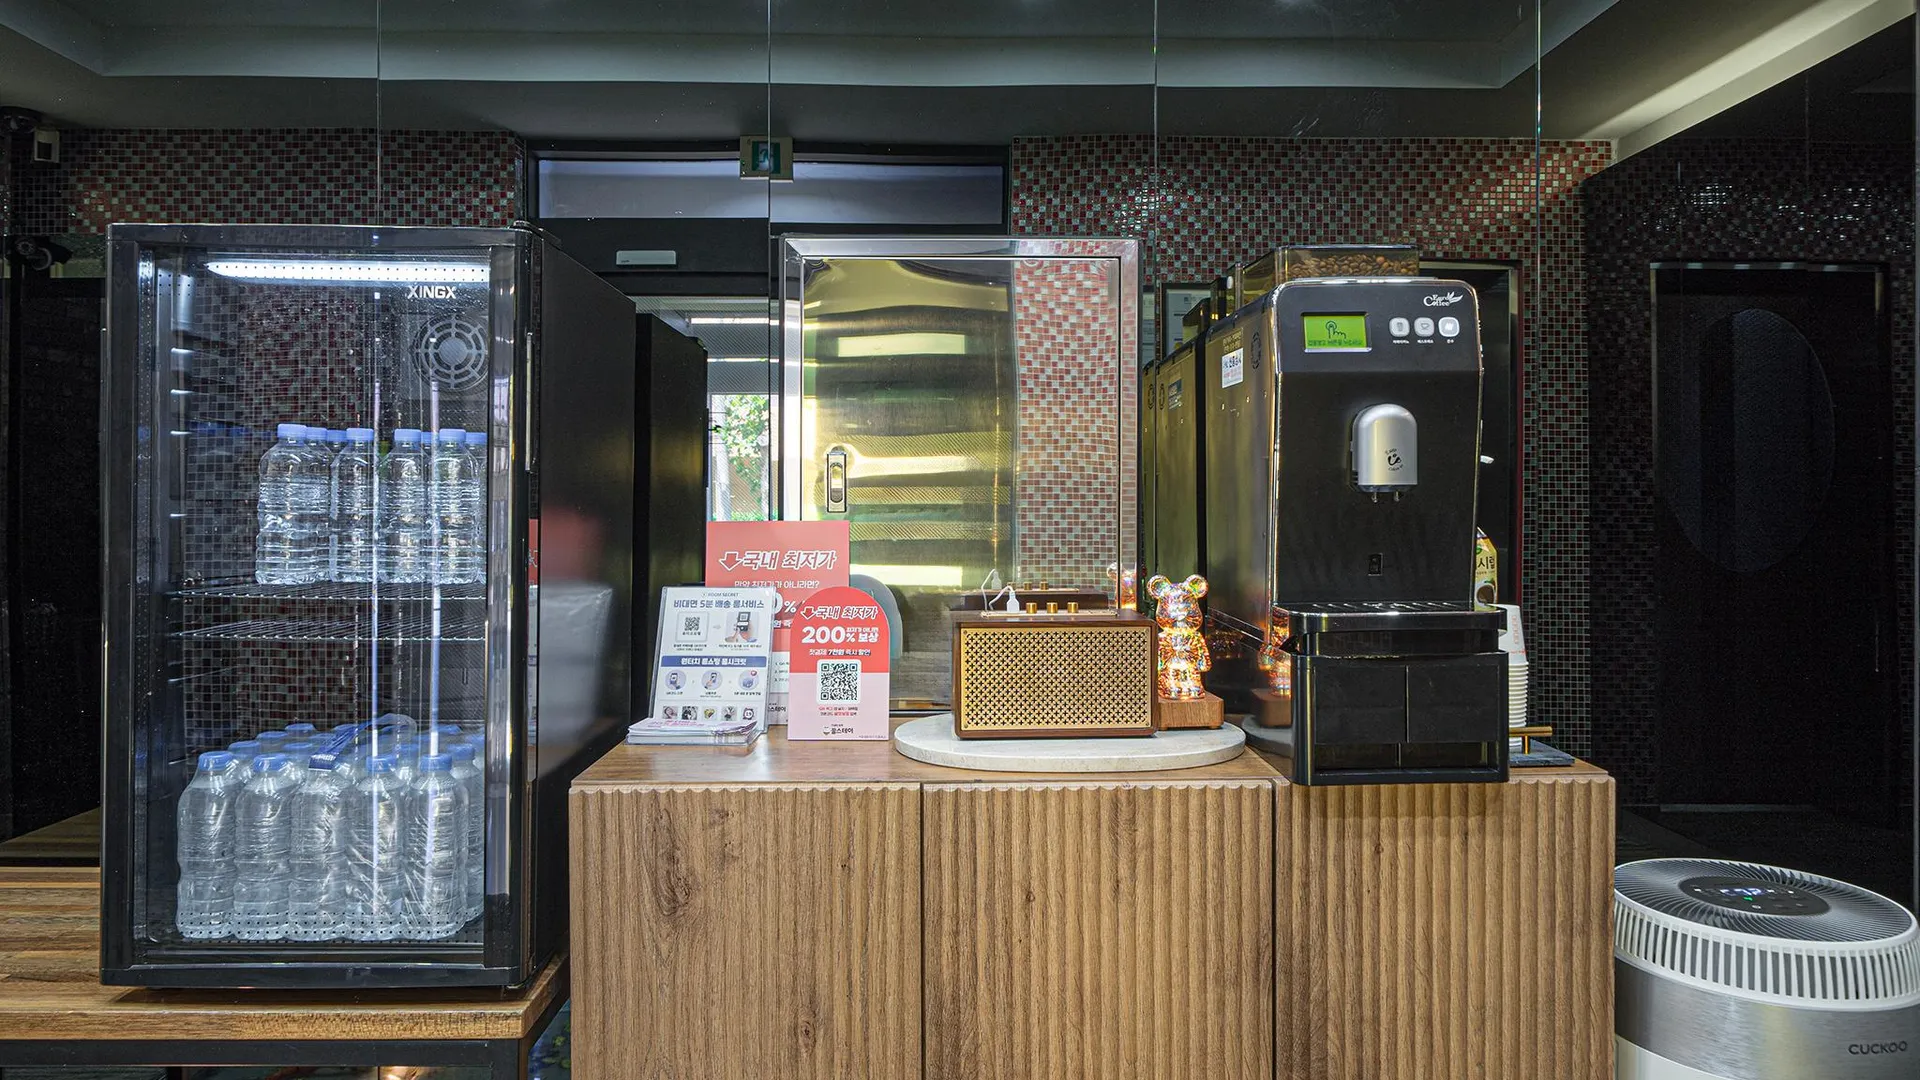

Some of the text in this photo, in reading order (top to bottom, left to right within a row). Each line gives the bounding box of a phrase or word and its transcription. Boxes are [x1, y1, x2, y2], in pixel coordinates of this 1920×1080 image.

[407, 285, 457, 299] XINGX
[743, 550, 837, 571] 국내 최저가
[783, 580, 820, 589] 아니라면?
[673, 599, 765, 608] 비대면 5분 배송 룸서비스
[816, 605, 878, 620] 국내 최저가
[858, 632, 879, 643] 보상
[681, 657, 700, 666] 원터치
[1848, 1040, 1908, 1055] CUCKOO
